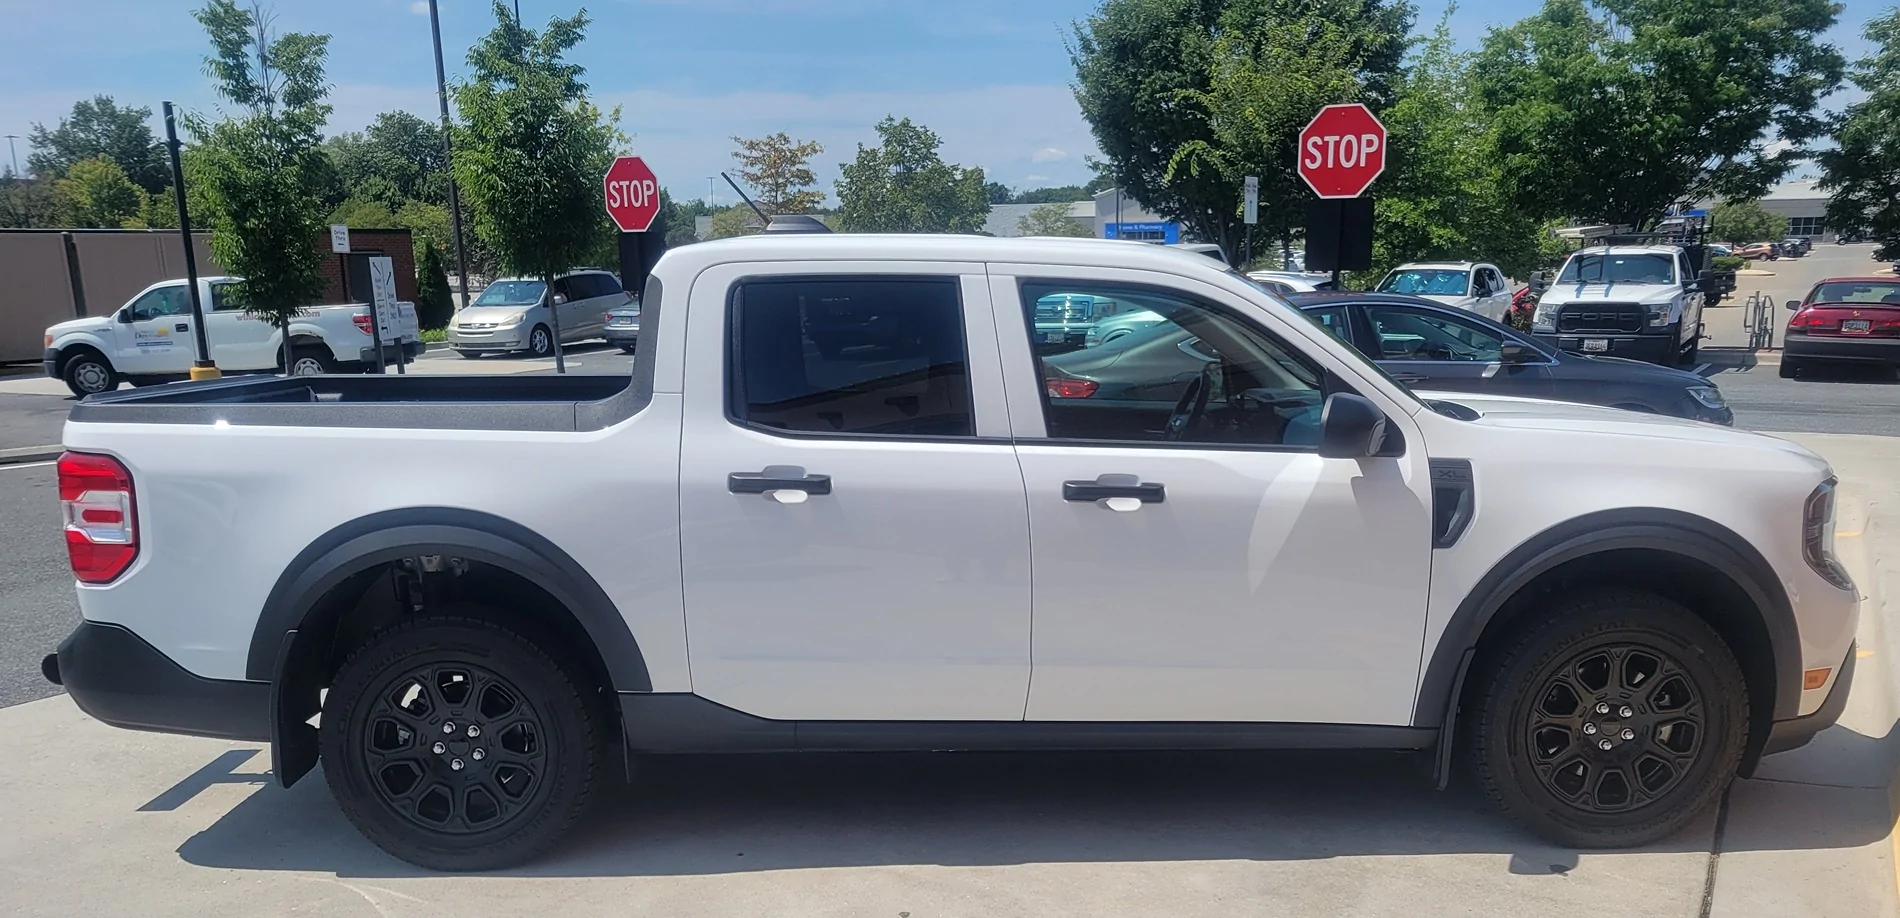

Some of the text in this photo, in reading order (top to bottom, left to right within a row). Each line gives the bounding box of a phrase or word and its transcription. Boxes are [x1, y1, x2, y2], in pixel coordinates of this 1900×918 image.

[1304, 133, 1379, 170] STOP
[609, 180, 655, 208] STOP
[1560, 312, 1637, 321] FORD
